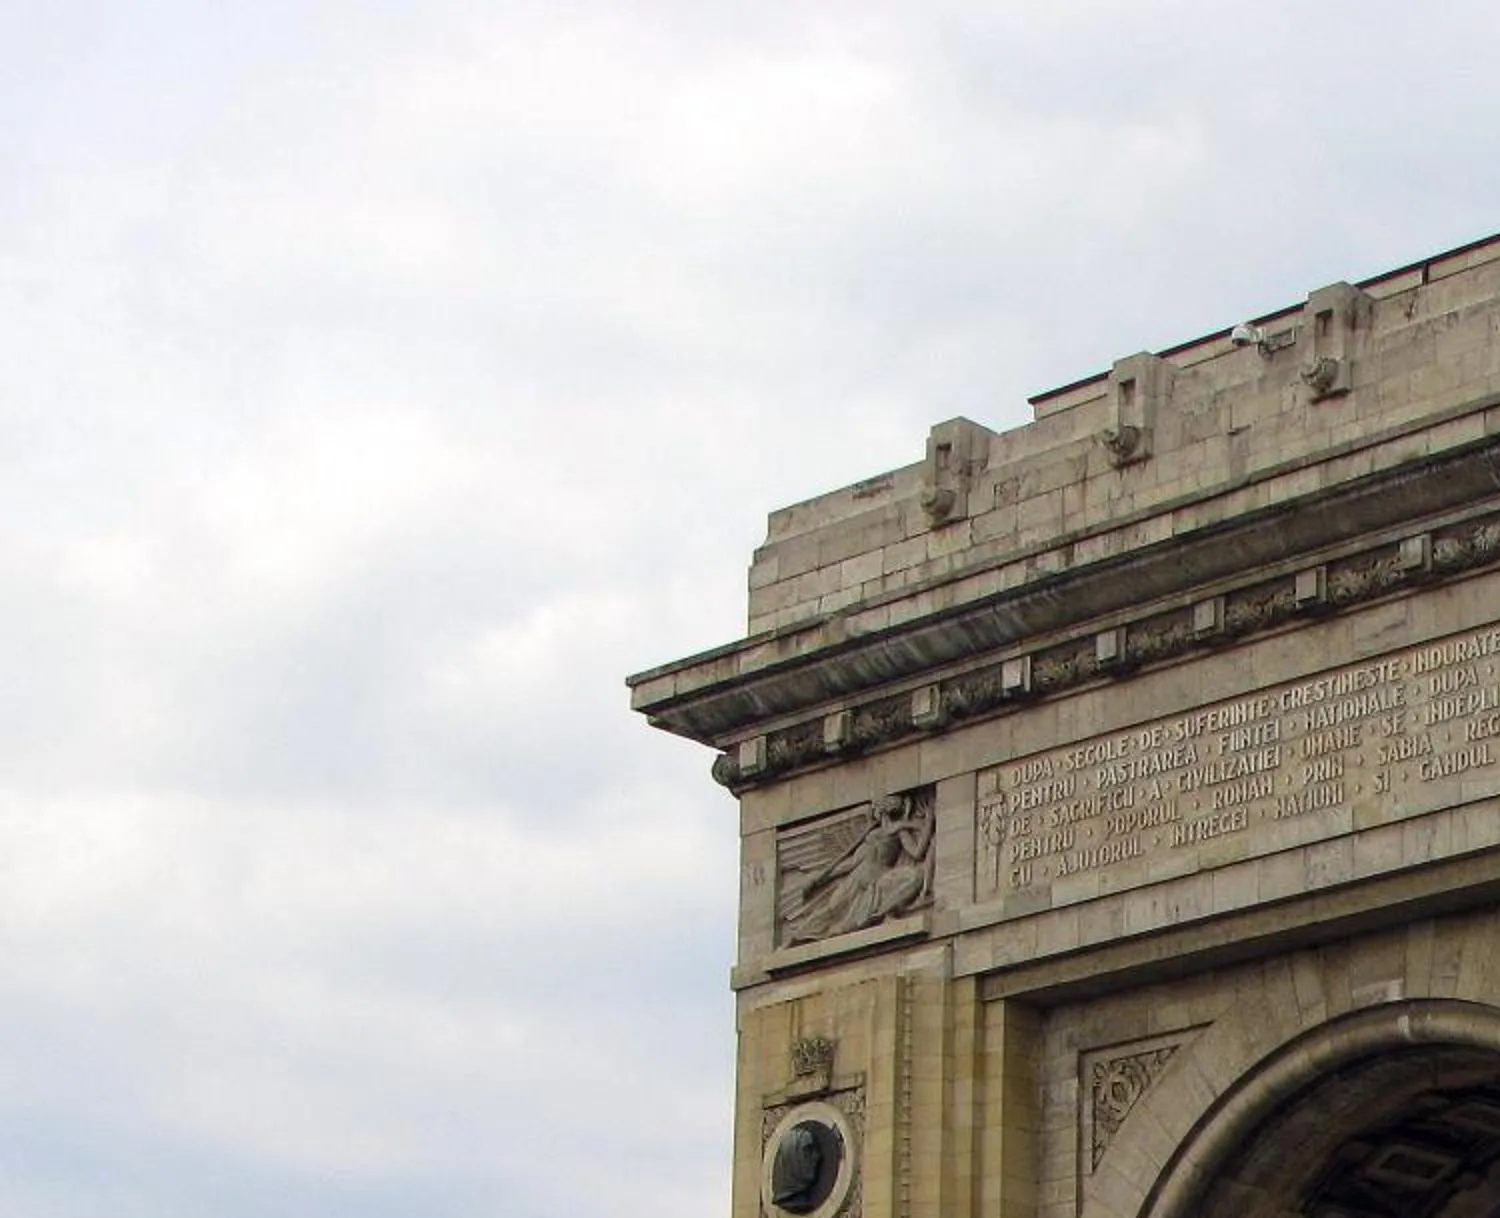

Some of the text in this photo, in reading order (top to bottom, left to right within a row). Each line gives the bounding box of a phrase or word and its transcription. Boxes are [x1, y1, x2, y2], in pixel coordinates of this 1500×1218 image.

[1010, 774, 1077, 814] PENTRU
[1097, 743, 1198, 789] PASTRAREA
[1305, 684, 1406, 731] NATIONALE
[1429, 665, 1479, 698] DUPA
[1010, 828, 1076, 864] PENTRU
[1105, 800, 1182, 841] POPORUL
[1213, 773, 1274, 811] ROMAN
[1303, 755, 1344, 786] PRIN
[1378, 735, 1434, 767] SABIA
[1011, 816, 1032, 837] DE
[1150, 777, 1163, 800] A
[1381, 711, 1406, 738] SE
[1012, 757, 1054, 787] DUPA
[1065, 736, 1129, 771] SECOLE
[1140, 728, 1162, 749] DE
[1174, 697, 1270, 741] SUFERINTE
[1010, 865, 1034, 889] CU
[1056, 833, 1143, 878] AJUTORUL
[1420, 744, 1496, 781] GANDUL
